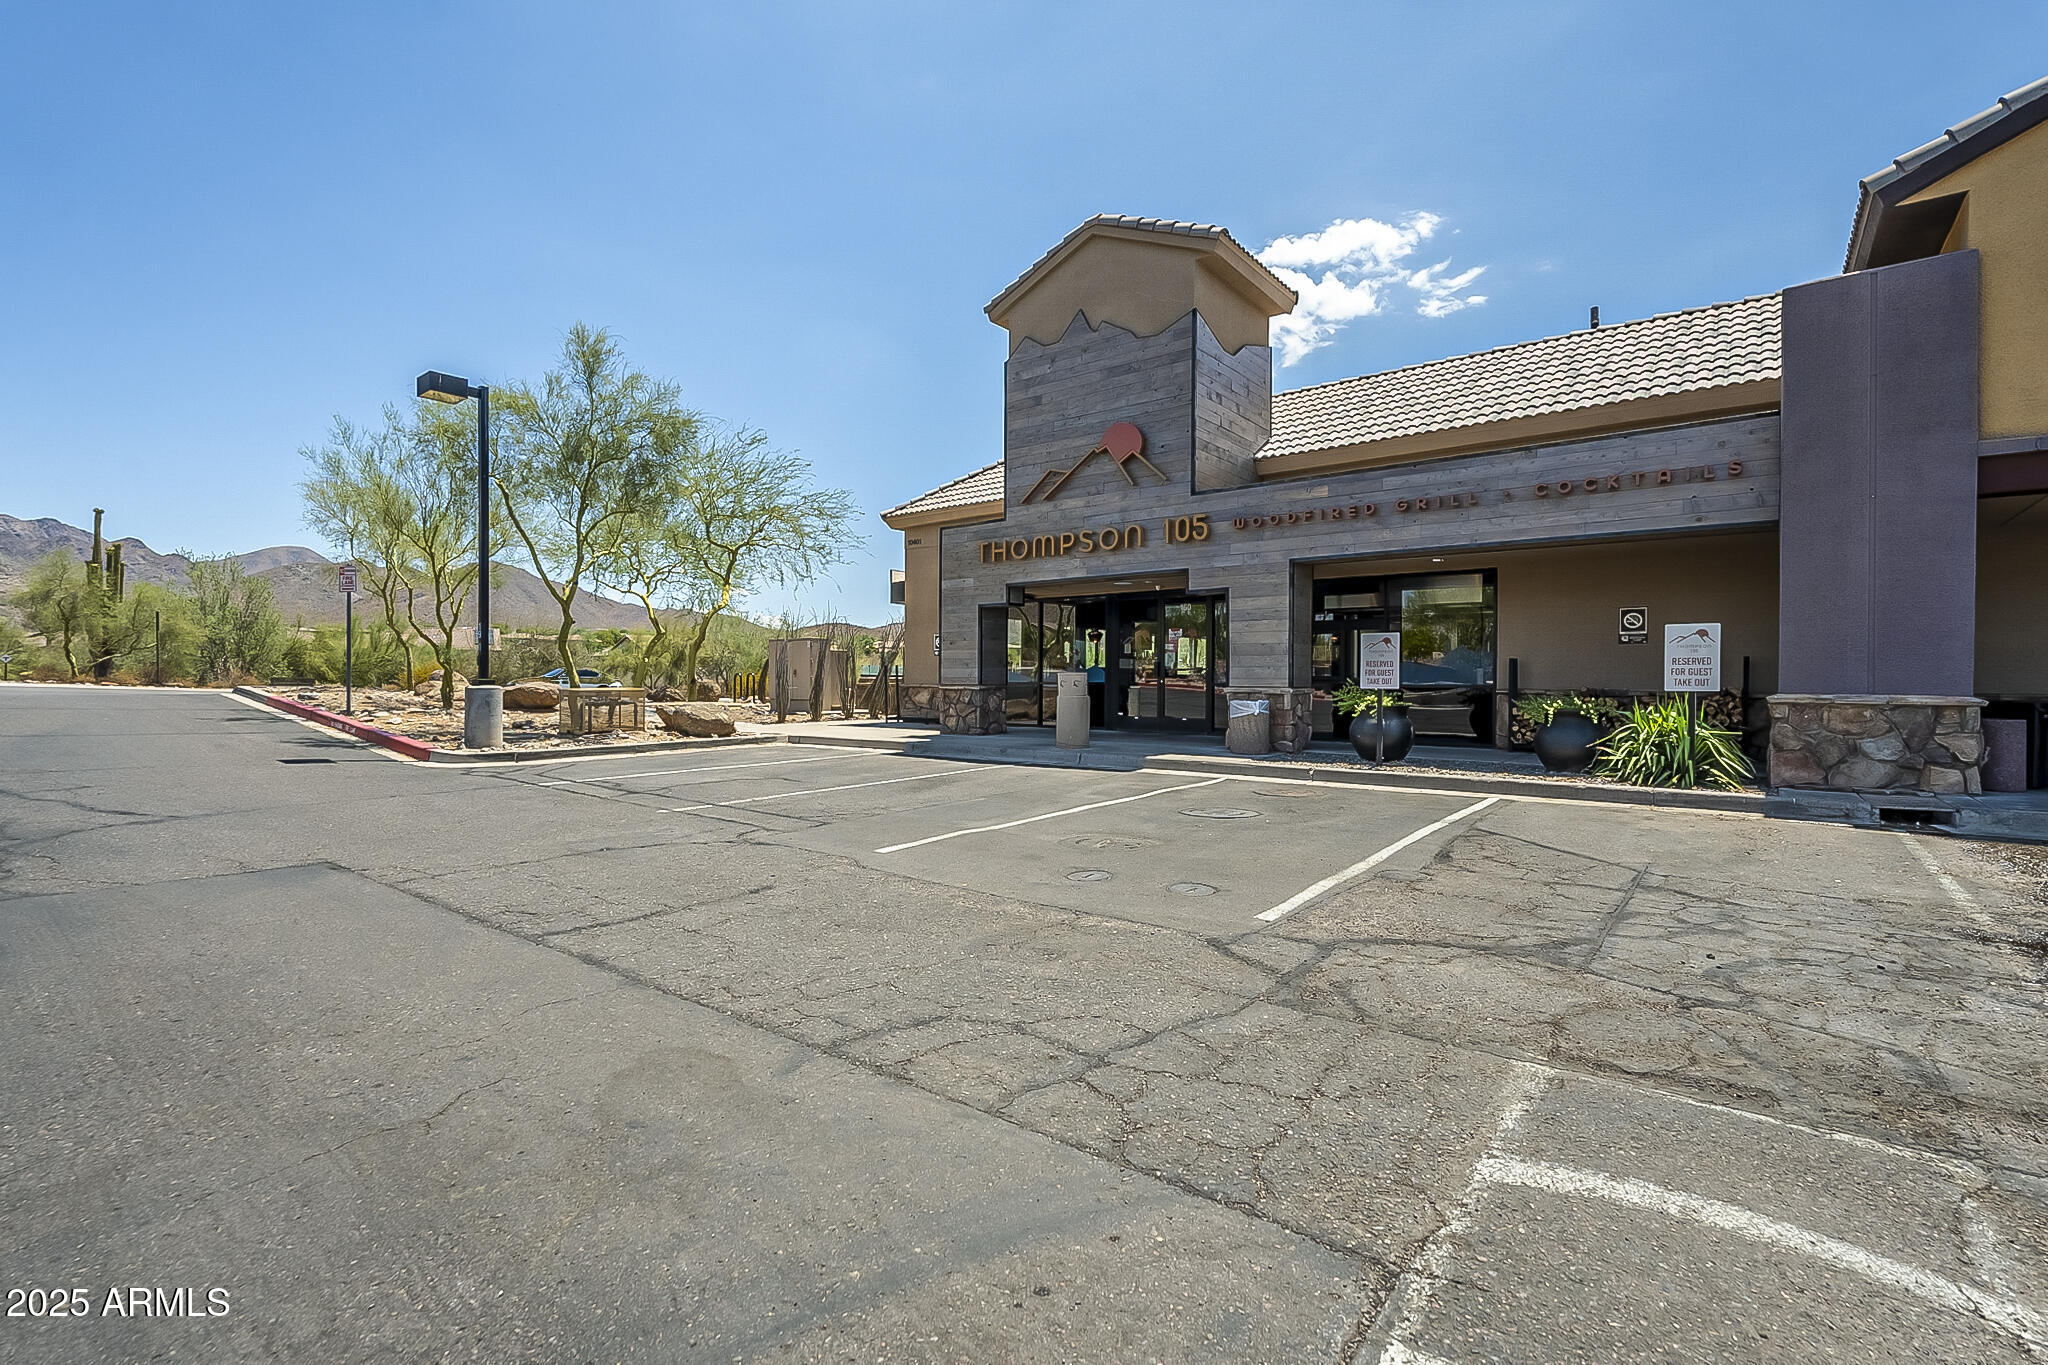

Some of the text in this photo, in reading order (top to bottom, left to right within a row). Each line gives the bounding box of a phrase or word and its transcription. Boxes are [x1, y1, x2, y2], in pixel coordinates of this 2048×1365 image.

[1232, 504, 1376, 529] WOODFIRED
[1395, 492, 1480, 511] GRILL
[1534, 459, 1744, 497] COCKTAILS
[978, 513, 1210, 563] THOMPSON 105
[1365, 660, 1394, 668] RESERVED
[1671, 657, 1712, 666] RESERVED
[1365, 669, 1394, 677] FOR GUEST
[1670, 667, 1713, 676] FOR GUEST
[1367, 677, 1393, 685] TAKE OUT
[1674, 678, 1711, 687] TAKE OUT
